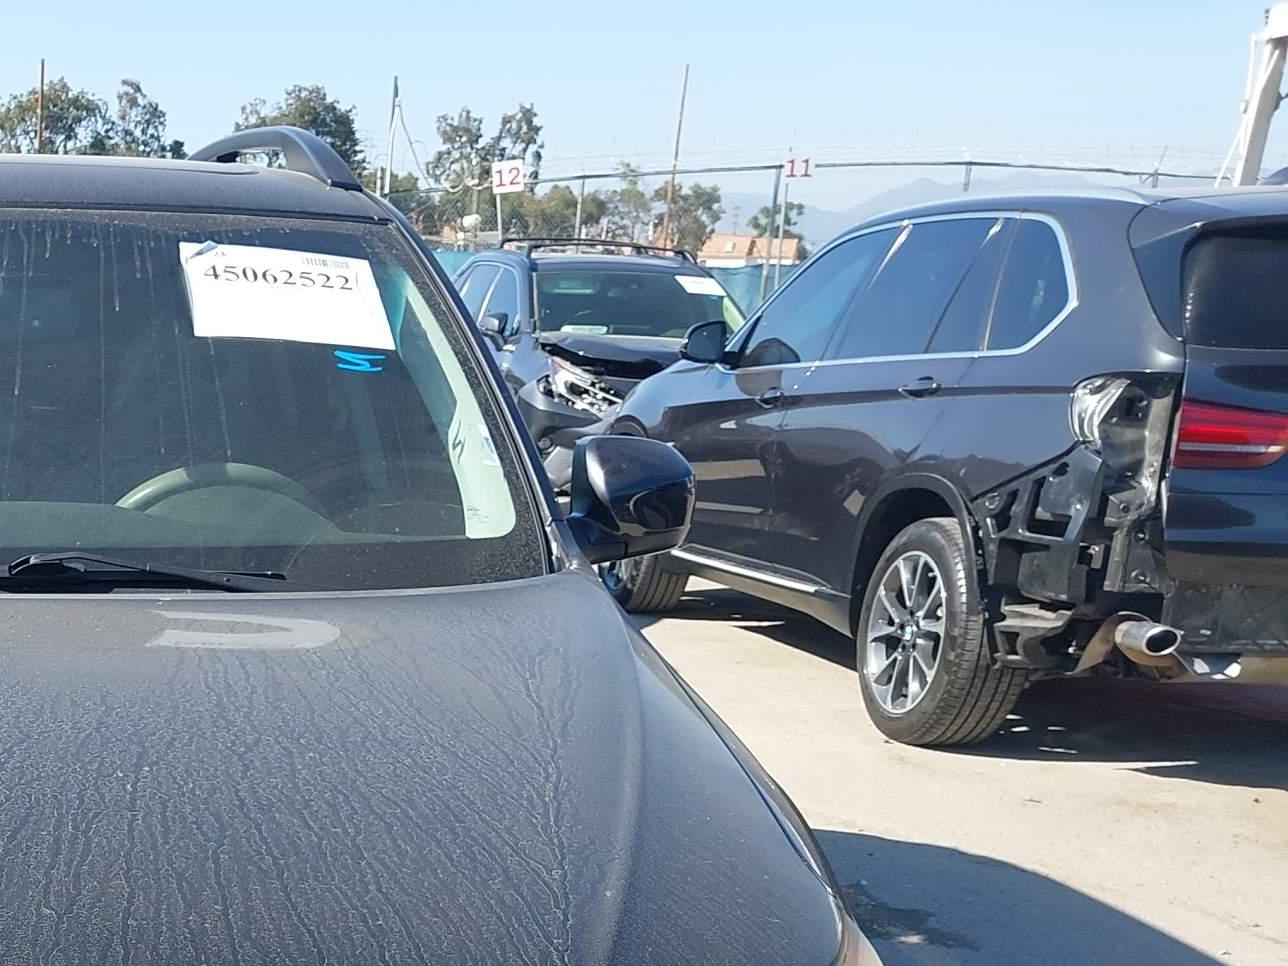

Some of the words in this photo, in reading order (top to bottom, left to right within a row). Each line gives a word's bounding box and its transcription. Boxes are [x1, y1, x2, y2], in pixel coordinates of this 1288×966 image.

[494, 166, 521, 188] 12
[785, 158, 812, 178] 11
[203, 264, 354, 291] 45062522
